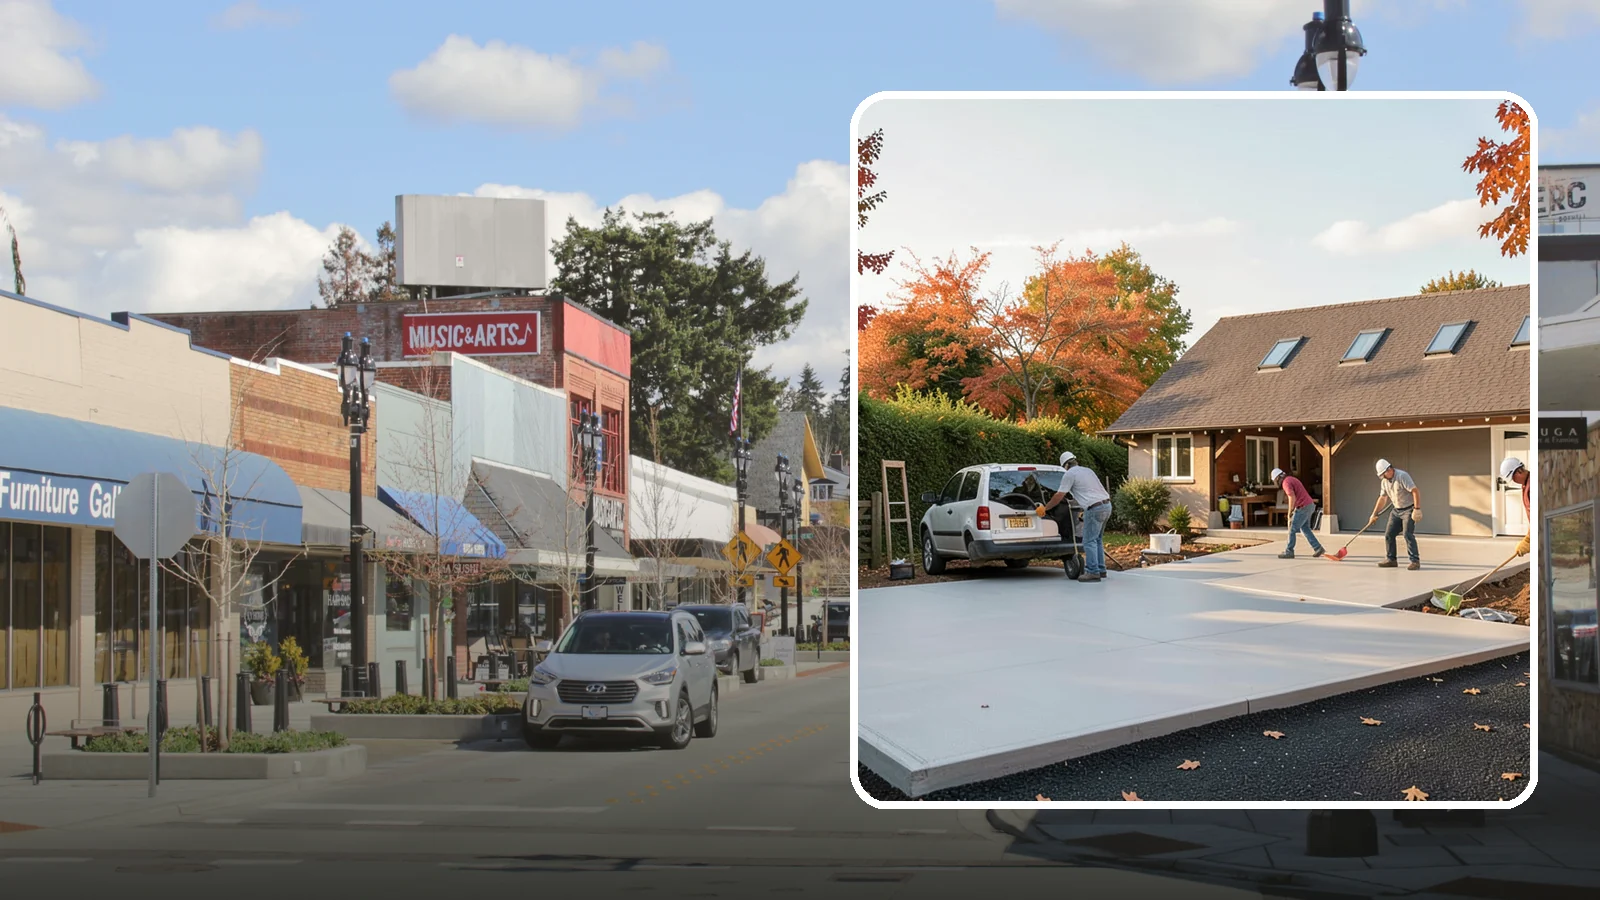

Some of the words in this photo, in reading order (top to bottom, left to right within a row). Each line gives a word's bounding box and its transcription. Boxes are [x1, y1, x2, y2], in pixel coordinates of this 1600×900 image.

[0, 472, 79, 515] Furniture
[89, 482, 122, 519] Gal
[453, 563, 479, 574] SUSHI
